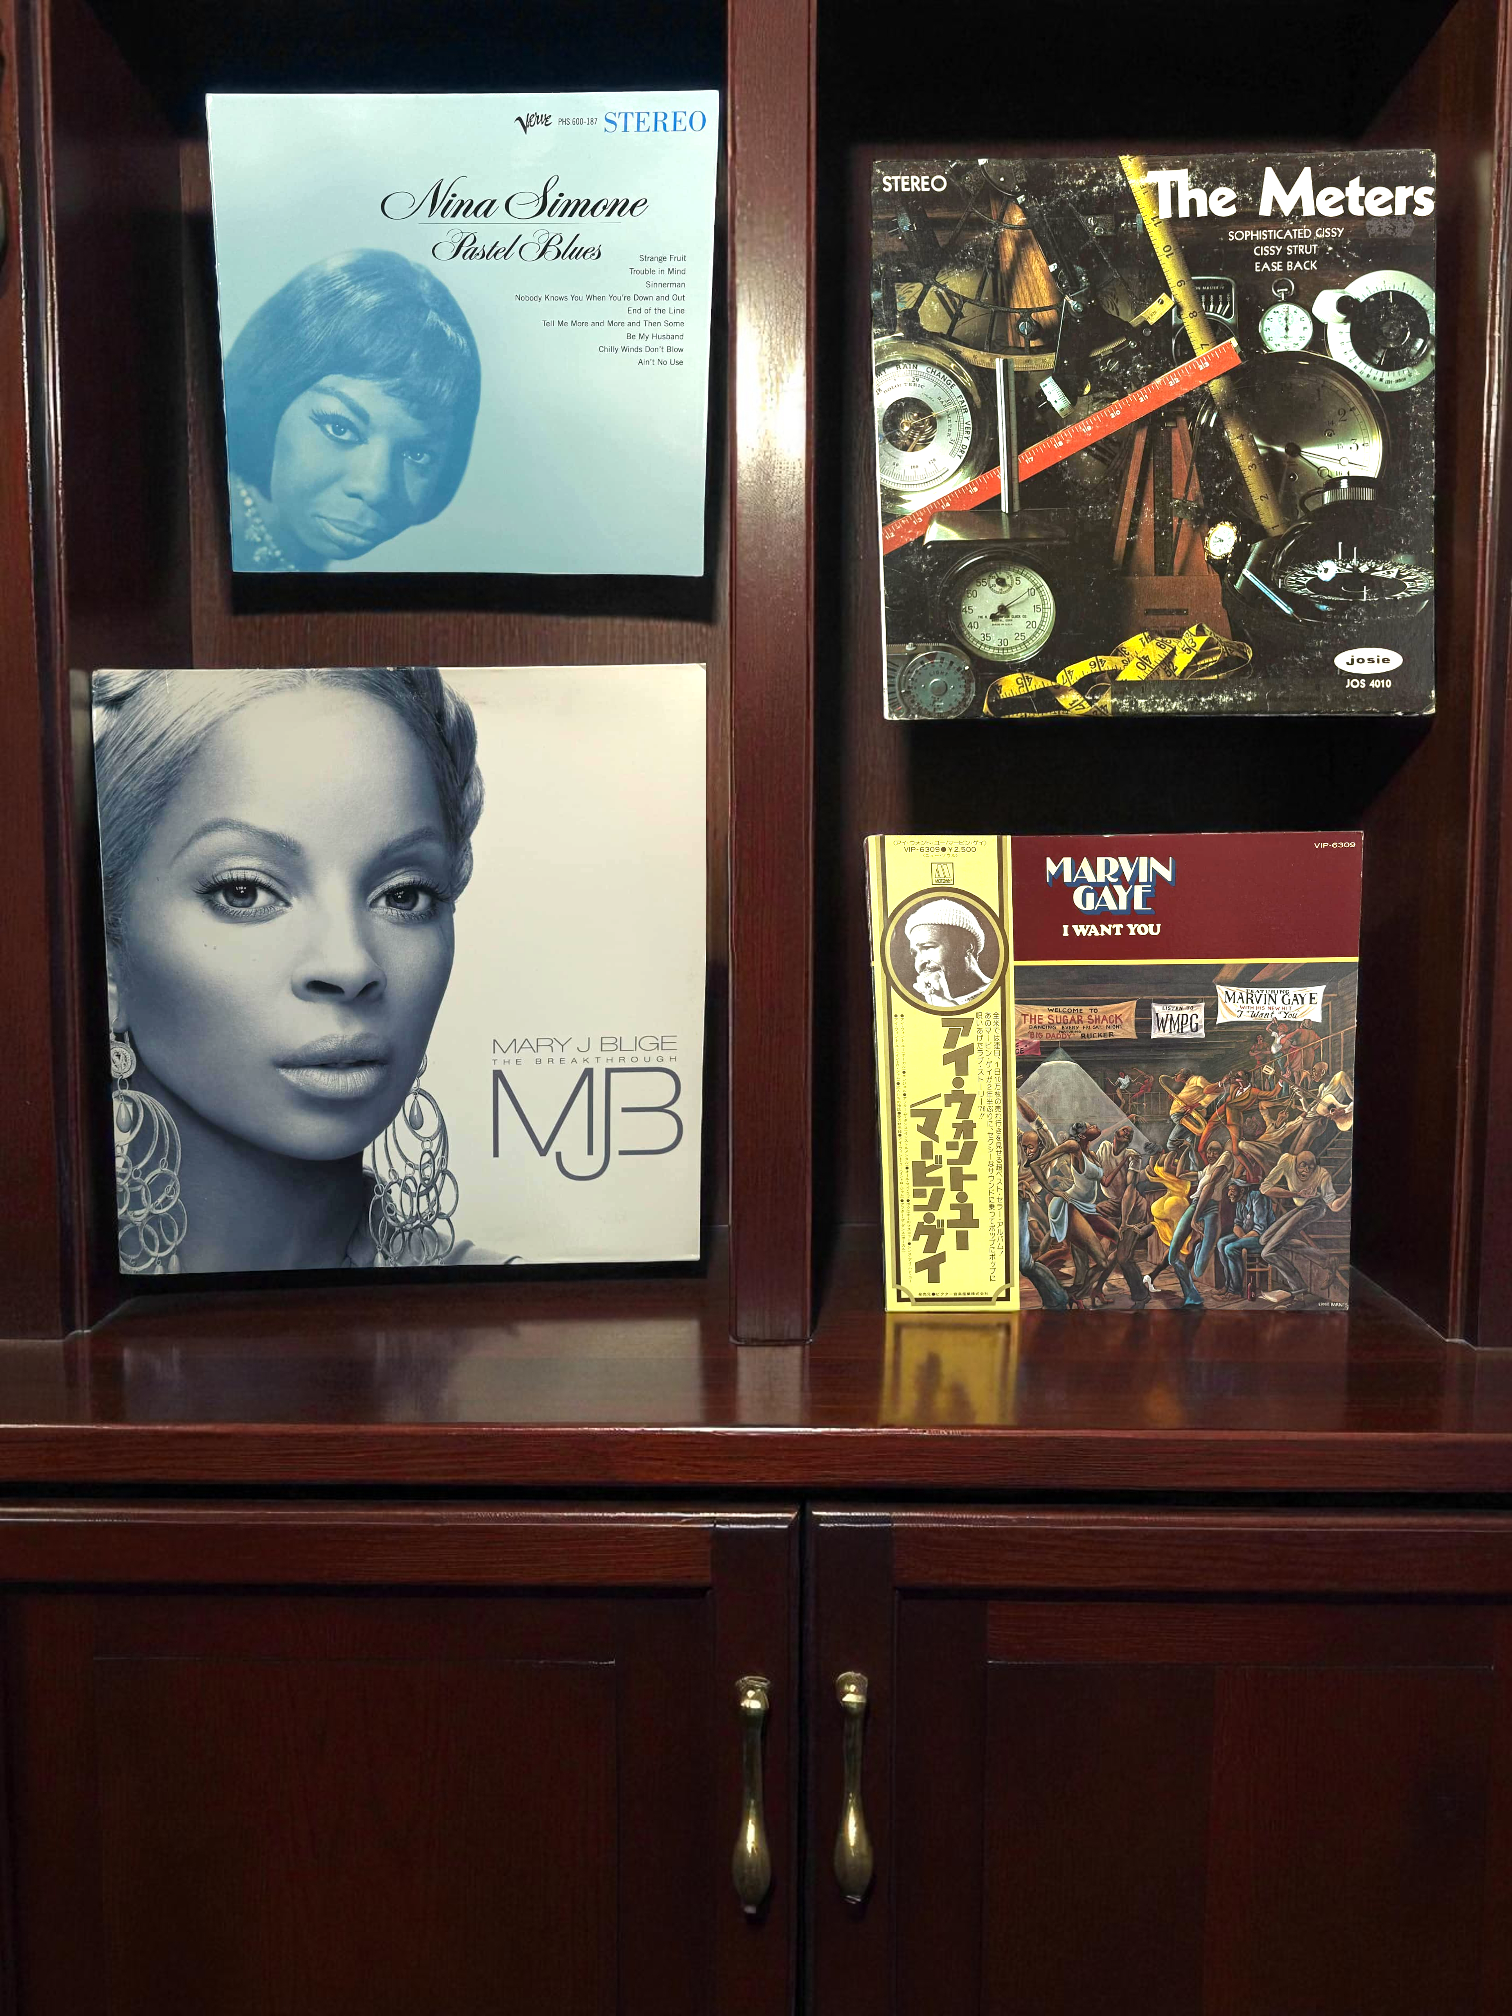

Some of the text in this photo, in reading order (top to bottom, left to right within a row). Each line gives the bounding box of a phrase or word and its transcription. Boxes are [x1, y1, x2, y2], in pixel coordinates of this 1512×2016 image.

[514, 112, 552, 135] Verve
[558, 117, 598, 126] PHS 600-187
[604, 110, 707, 133] STEREO
[882, 175, 947, 192] STEREO
[380, 175, 649, 220] Nina Simone
[1147, 167, 1435, 219] The Meters
[1228, 227, 1345, 241] SOPHISTICATED CISSY
[431, 228, 602, 262] Pastel Blues
[1253, 244, 1318, 256] CISSY STRUT
[639, 254, 687, 263] Strange Fruit
[629, 267, 687, 275] Trouble in Mind
[1254, 260, 1318, 272] EASE BACK
[515, 294, 686, 303] Nobody Knows You When You're Down and Out
[627, 306, 685, 314] End of the Line
[542, 319, 685, 327] Tell Me More and More and Then Some
[626, 332, 684, 341] Be My Husband
[598, 345, 684, 354] Chilly Winds Don't Blow
[637, 358, 684, 366] Ain't No Use
[925, 366, 956, 389] CHANGE
[957, 394, 969, 414] FAIR
[1338, 408, 1347, 422] 2
[963, 420, 972, 441] VERY
[1350, 438, 1359, 451] 3
[957, 444, 967, 459] DRY
[976, 578, 987, 587] 55
[1015, 577, 1021, 586] 5
[967, 590, 977, 598] 50
[1028, 588, 1036, 596] 10
[962, 606, 973, 614] 45
[1033, 605, 1041, 613] 15
[967, 621, 979, 629] 40
[1026, 621, 1037, 629] 20
[981, 633, 991, 641] 35
[998, 638, 1008, 647] 30
[1014, 633, 1026, 641] 25
[1346, 655, 1391, 666] josie
[1345, 678, 1392, 688] JOS 4010
[1313, 841, 1356, 849] VIP-6309
[1046, 856, 1176, 887] MARVIN
[1072, 885, 1155, 915] GAYE
[1062, 923, 1161, 936] I WANT YOU
[1224, 990, 1318, 1005] MARVIN GAYE
[1021, 1013, 1123, 1024] THE SUGAR SHACK
[1155, 1012, 1199, 1033] WMPG
[492, 1035, 678, 1054] MARY J BLIGE
[492, 1056, 677, 1066] THE BREAKTHROUGH
[492, 1066, 684, 1181] MJB
